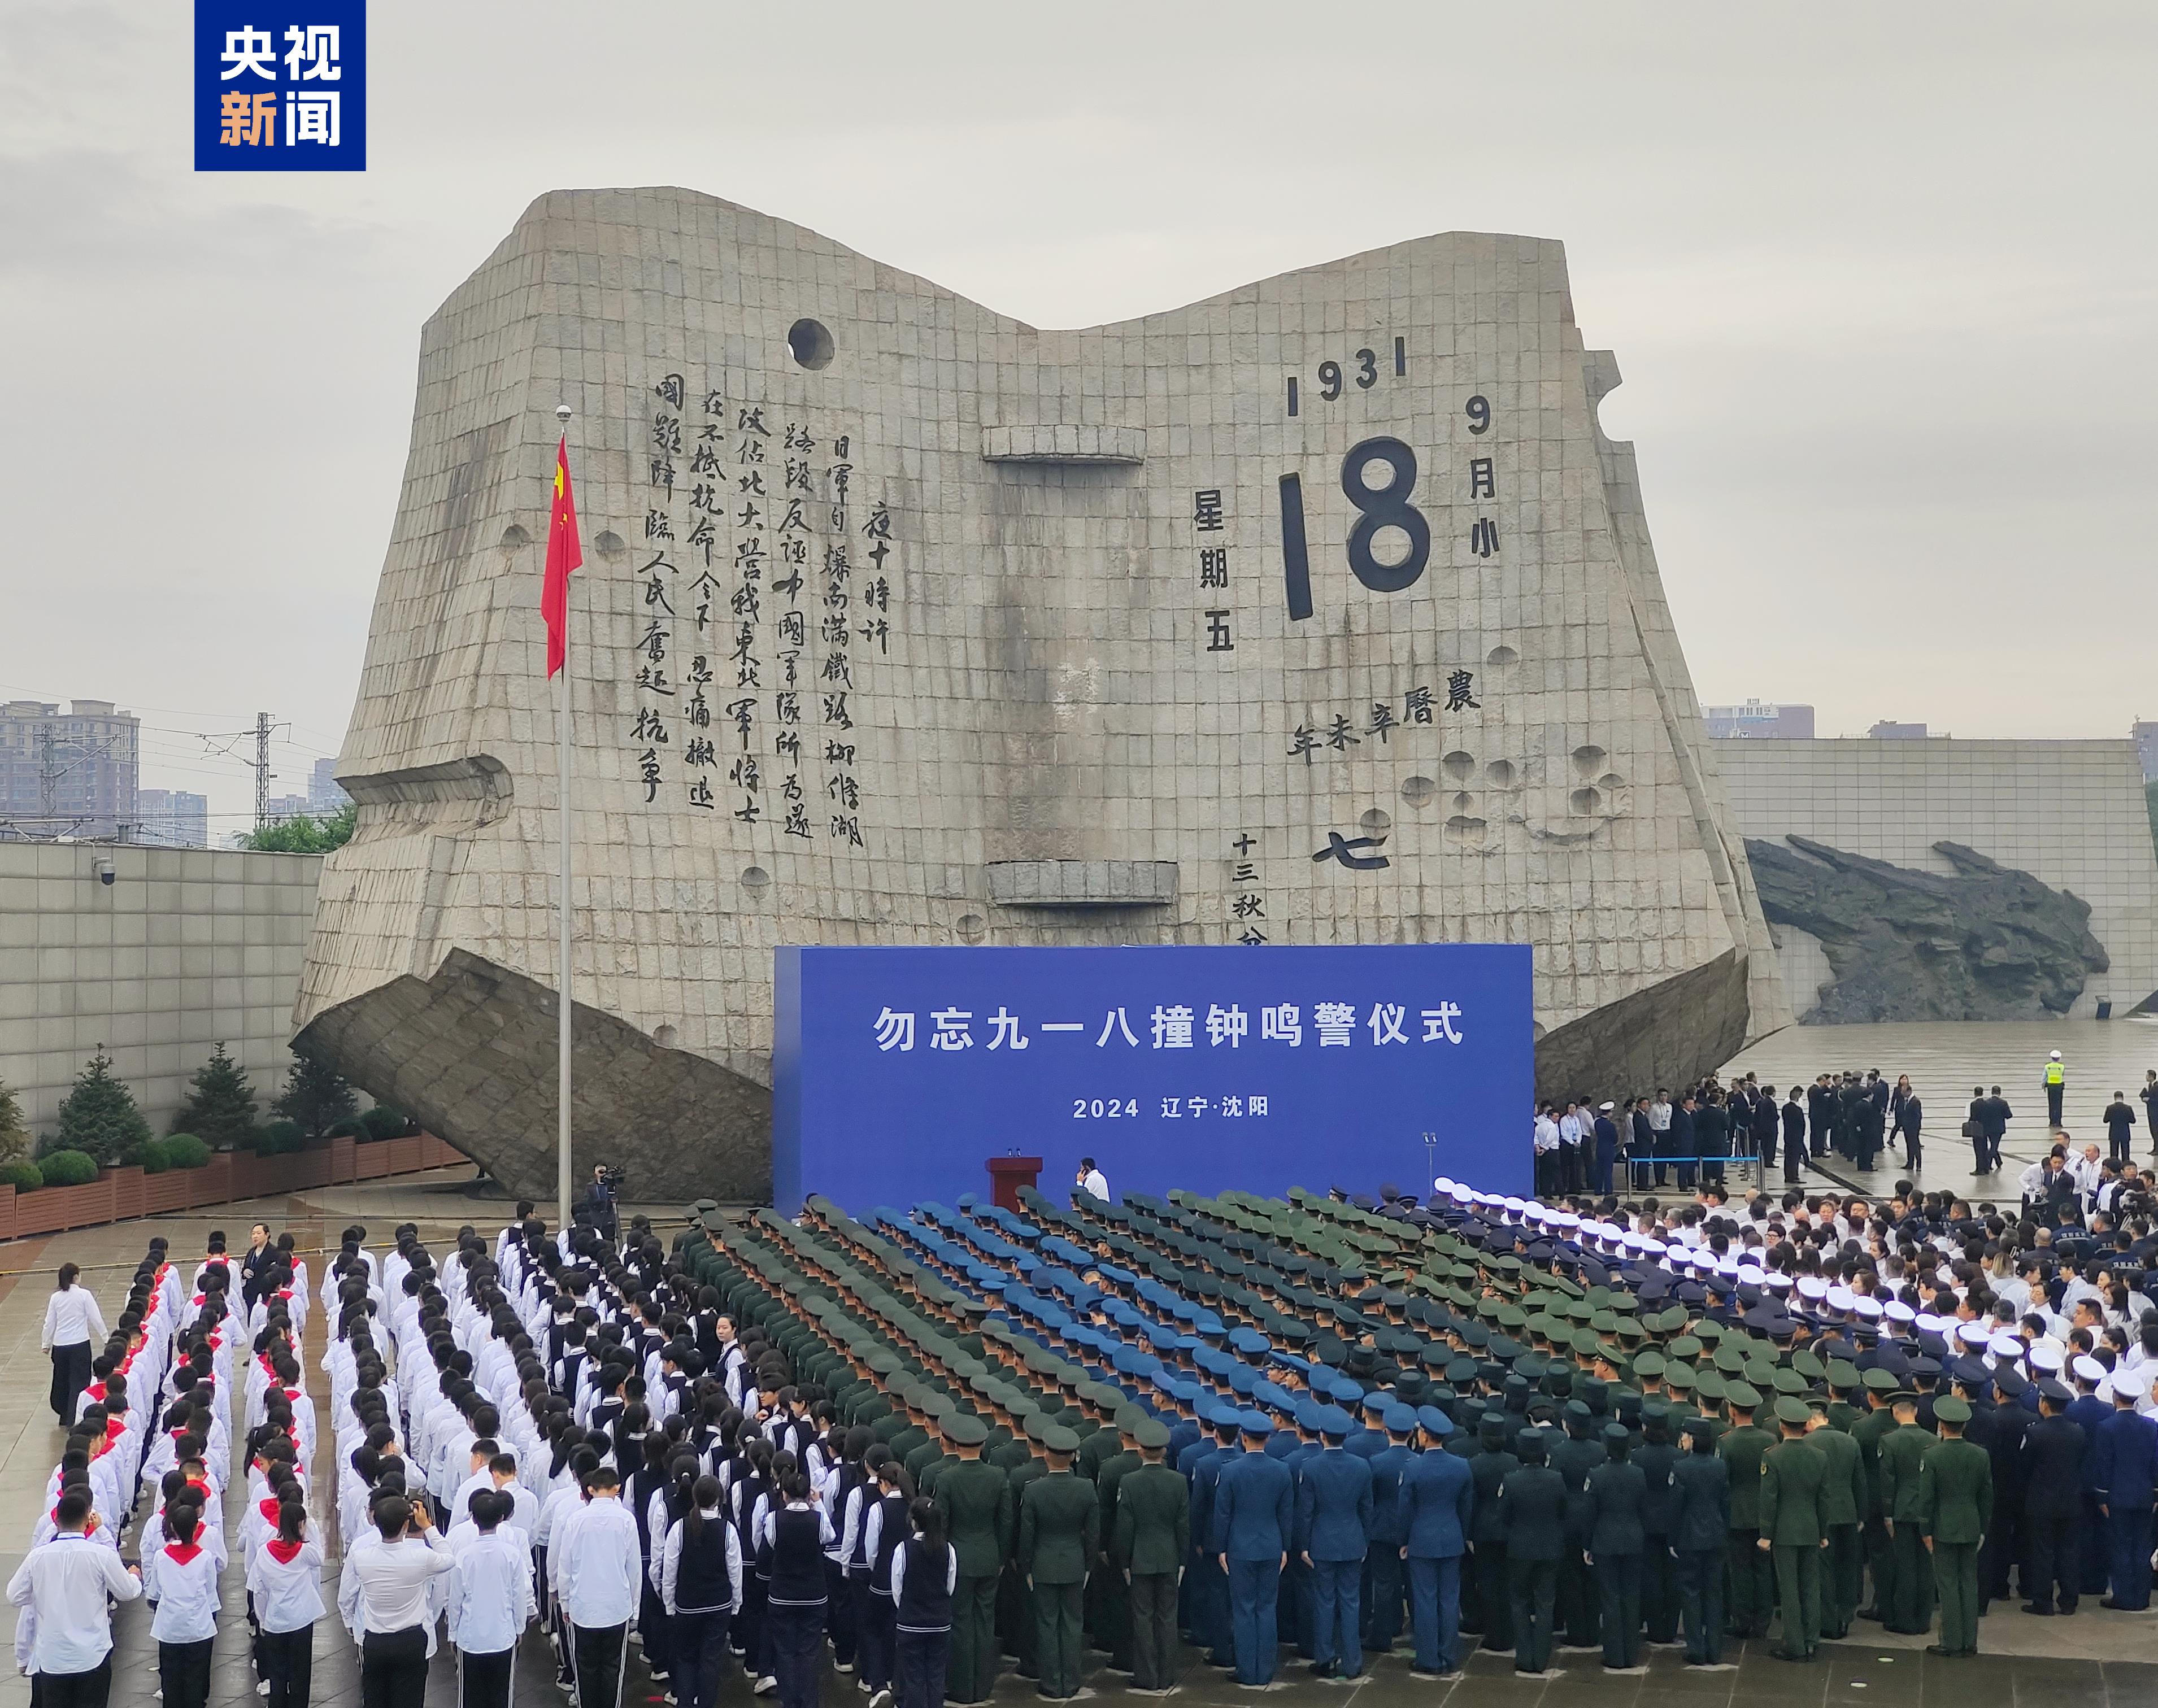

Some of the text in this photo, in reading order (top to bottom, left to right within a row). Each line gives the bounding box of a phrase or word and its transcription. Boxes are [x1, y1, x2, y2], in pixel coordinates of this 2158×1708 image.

[1287, 336, 1406, 417] 1931
[1278, 436, 1430, 621] 18
[1193, 489, 1234, 652] 星期五
[1312, 831, 1390, 870] 七
[873, 1000, 1464, 1052] 勿忘九一八撞钟鸣警仪式
[1073, 1099, 1139, 1118] 2024
